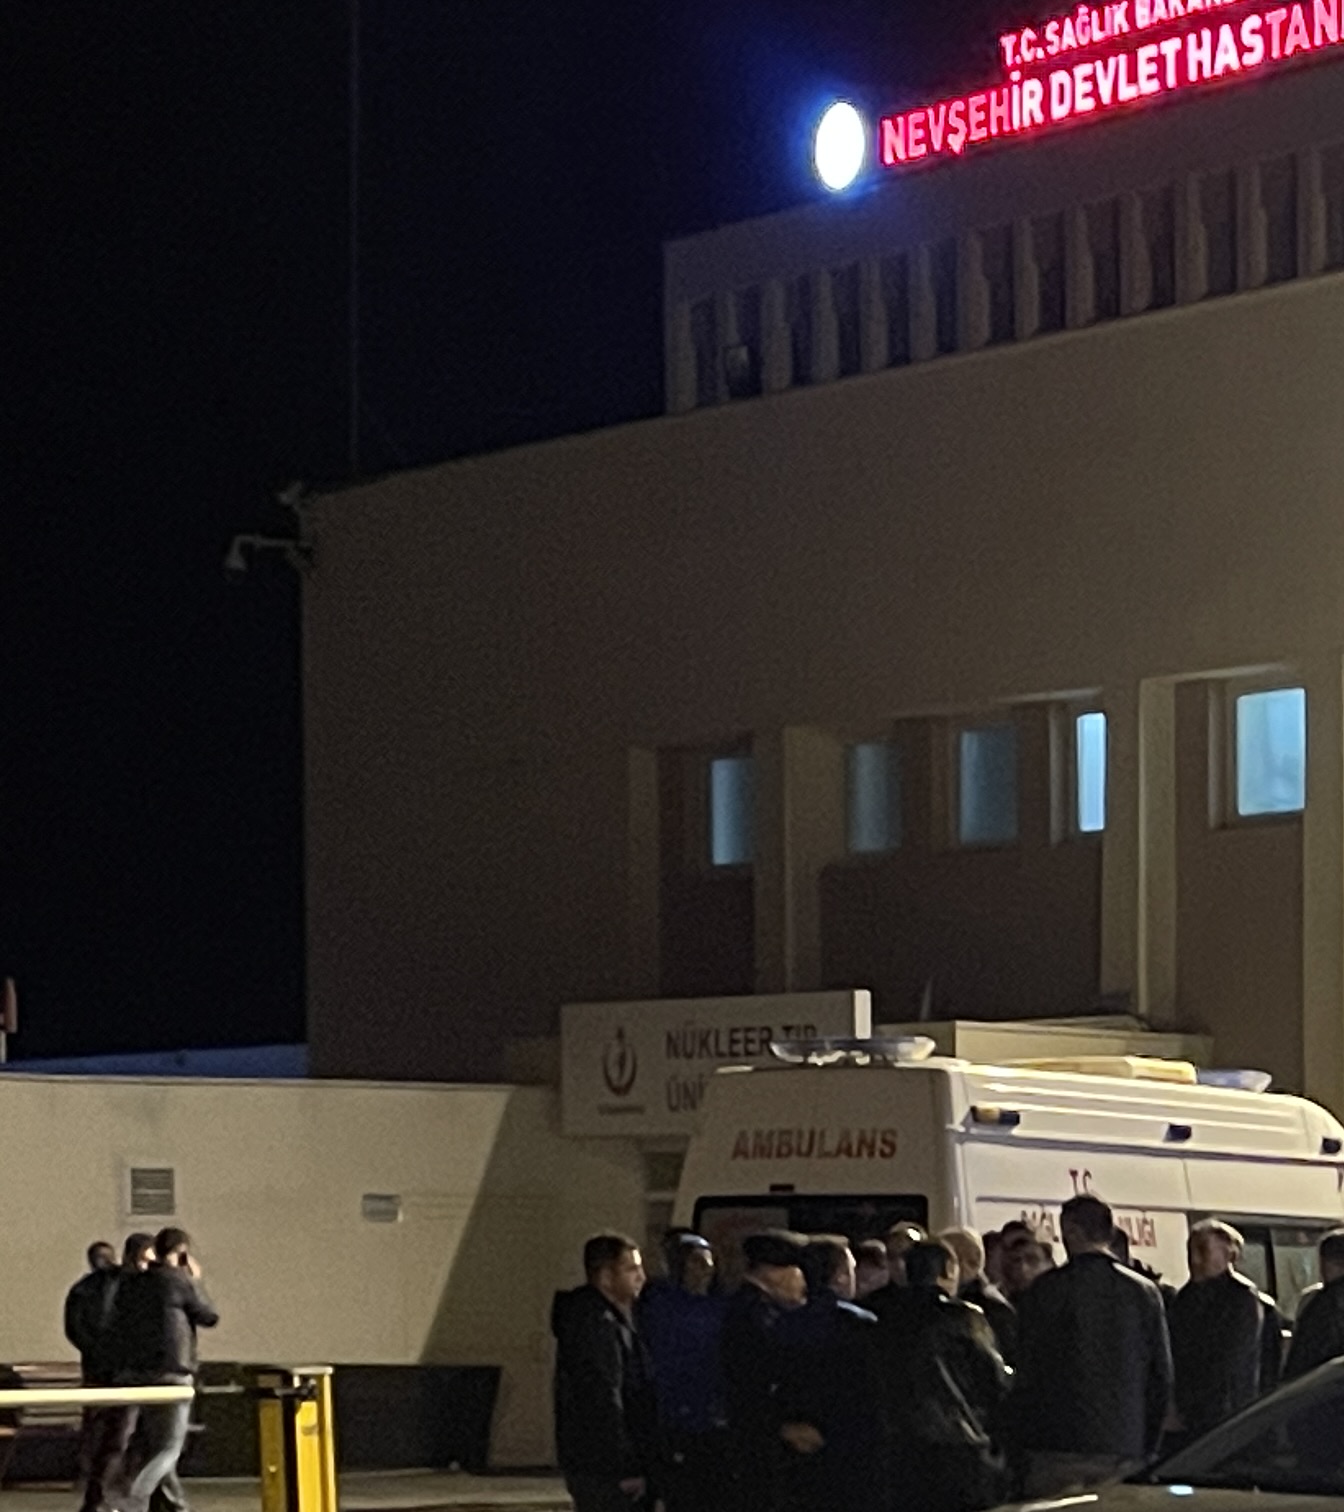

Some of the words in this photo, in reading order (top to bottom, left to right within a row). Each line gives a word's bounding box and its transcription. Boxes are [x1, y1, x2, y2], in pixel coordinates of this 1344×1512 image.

[1000, 27, 1045, 67] T.C.
[1045, 1, 1130, 55] SAĞLIK
[882, 71, 1042, 167] NEVŞEHİR
[1049, 37, 1182, 119] DEVLET
[665, 1020, 774, 1060] NÜKLEER
[731, 1127, 898, 1161] AMBULANS
